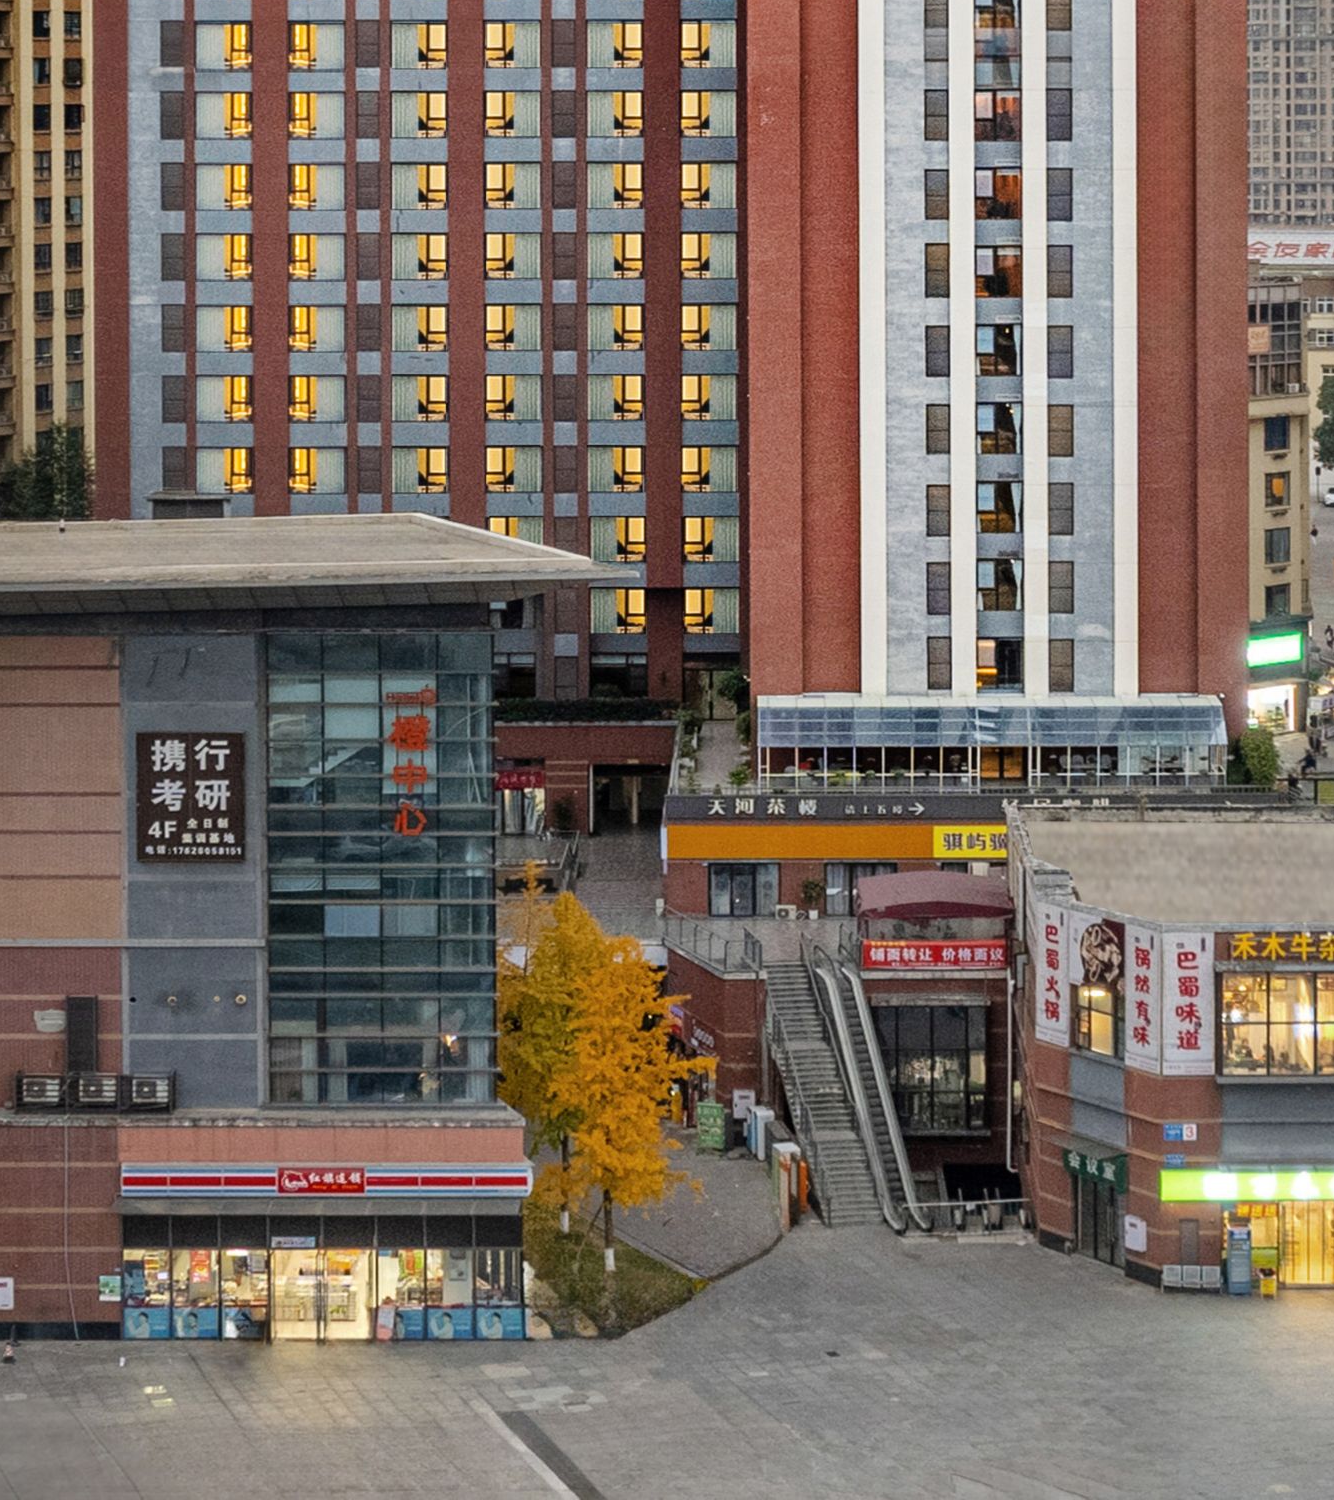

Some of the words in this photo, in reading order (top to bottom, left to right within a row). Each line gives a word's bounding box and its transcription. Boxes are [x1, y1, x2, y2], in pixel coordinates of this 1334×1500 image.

[151, 739, 230, 772] 携行
[151, 779, 231, 812] 考研
[708, 799, 817, 815] 天河茶楼
[148, 821, 177, 839] 4F
[1175, 951, 1201, 1050] 巴蜀味道
